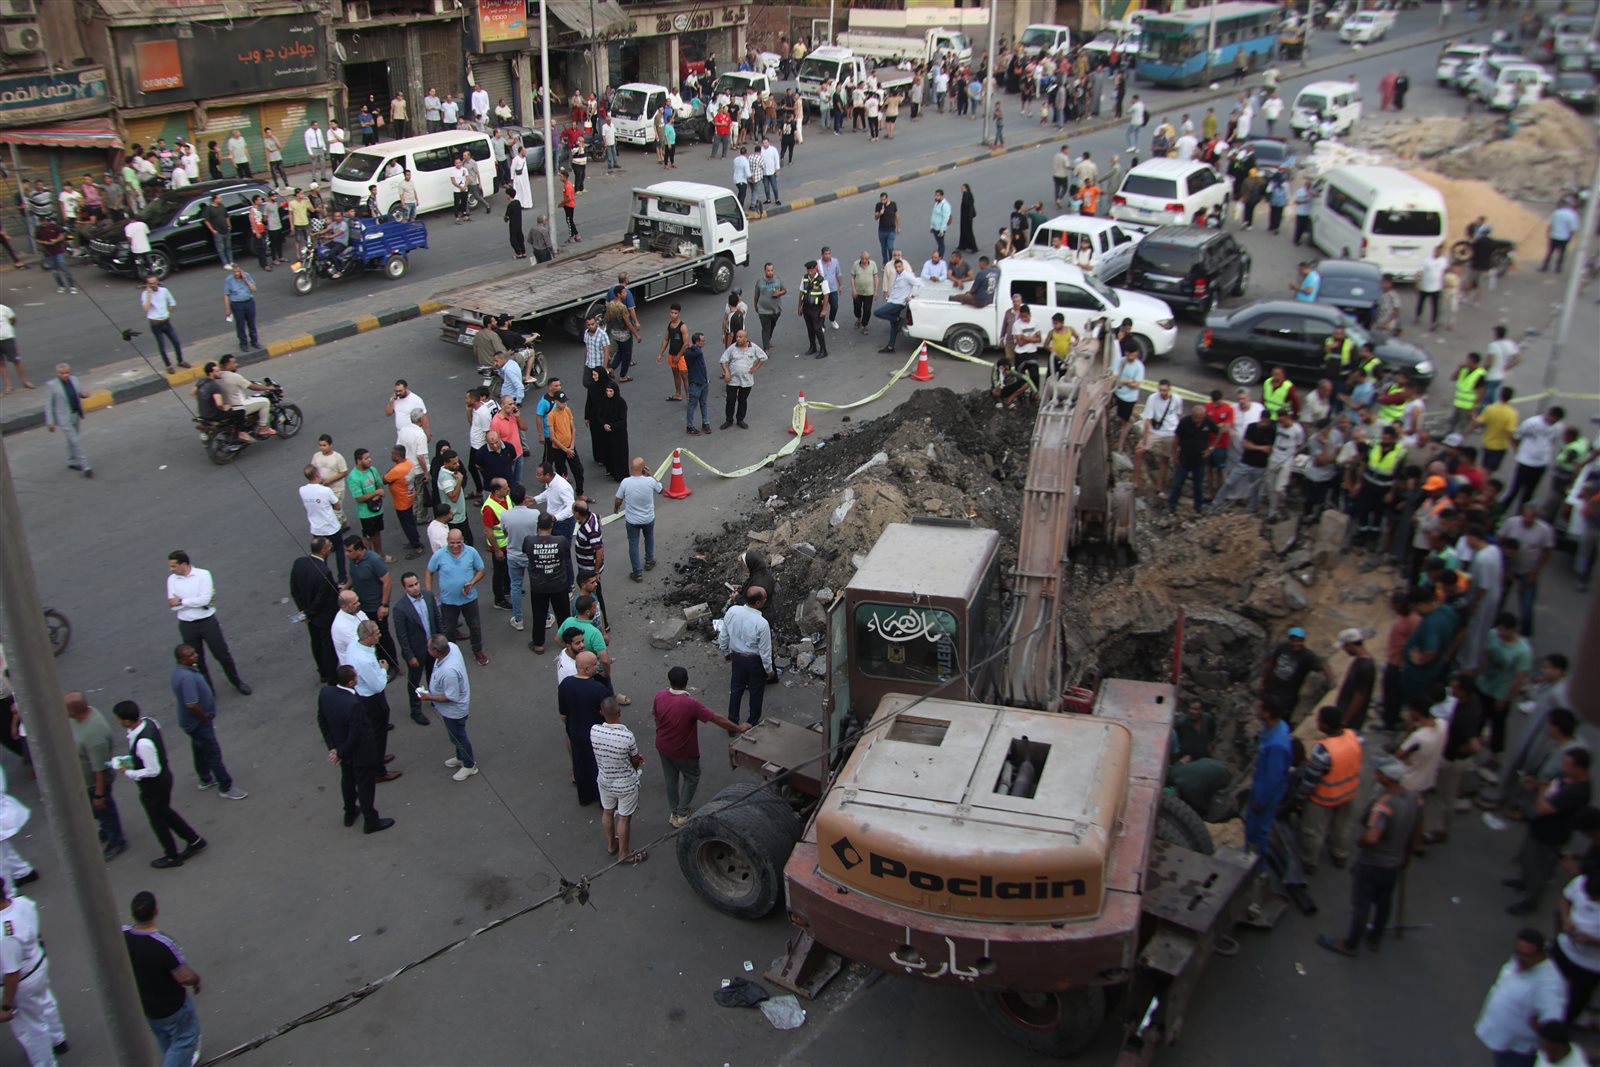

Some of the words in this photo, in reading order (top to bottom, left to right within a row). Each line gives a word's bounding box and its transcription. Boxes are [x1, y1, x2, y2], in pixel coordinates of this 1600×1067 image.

[278, 40, 315, 59] جولدن
[143, 76, 179, 88] orange
[869, 852, 1086, 899] Poclain
